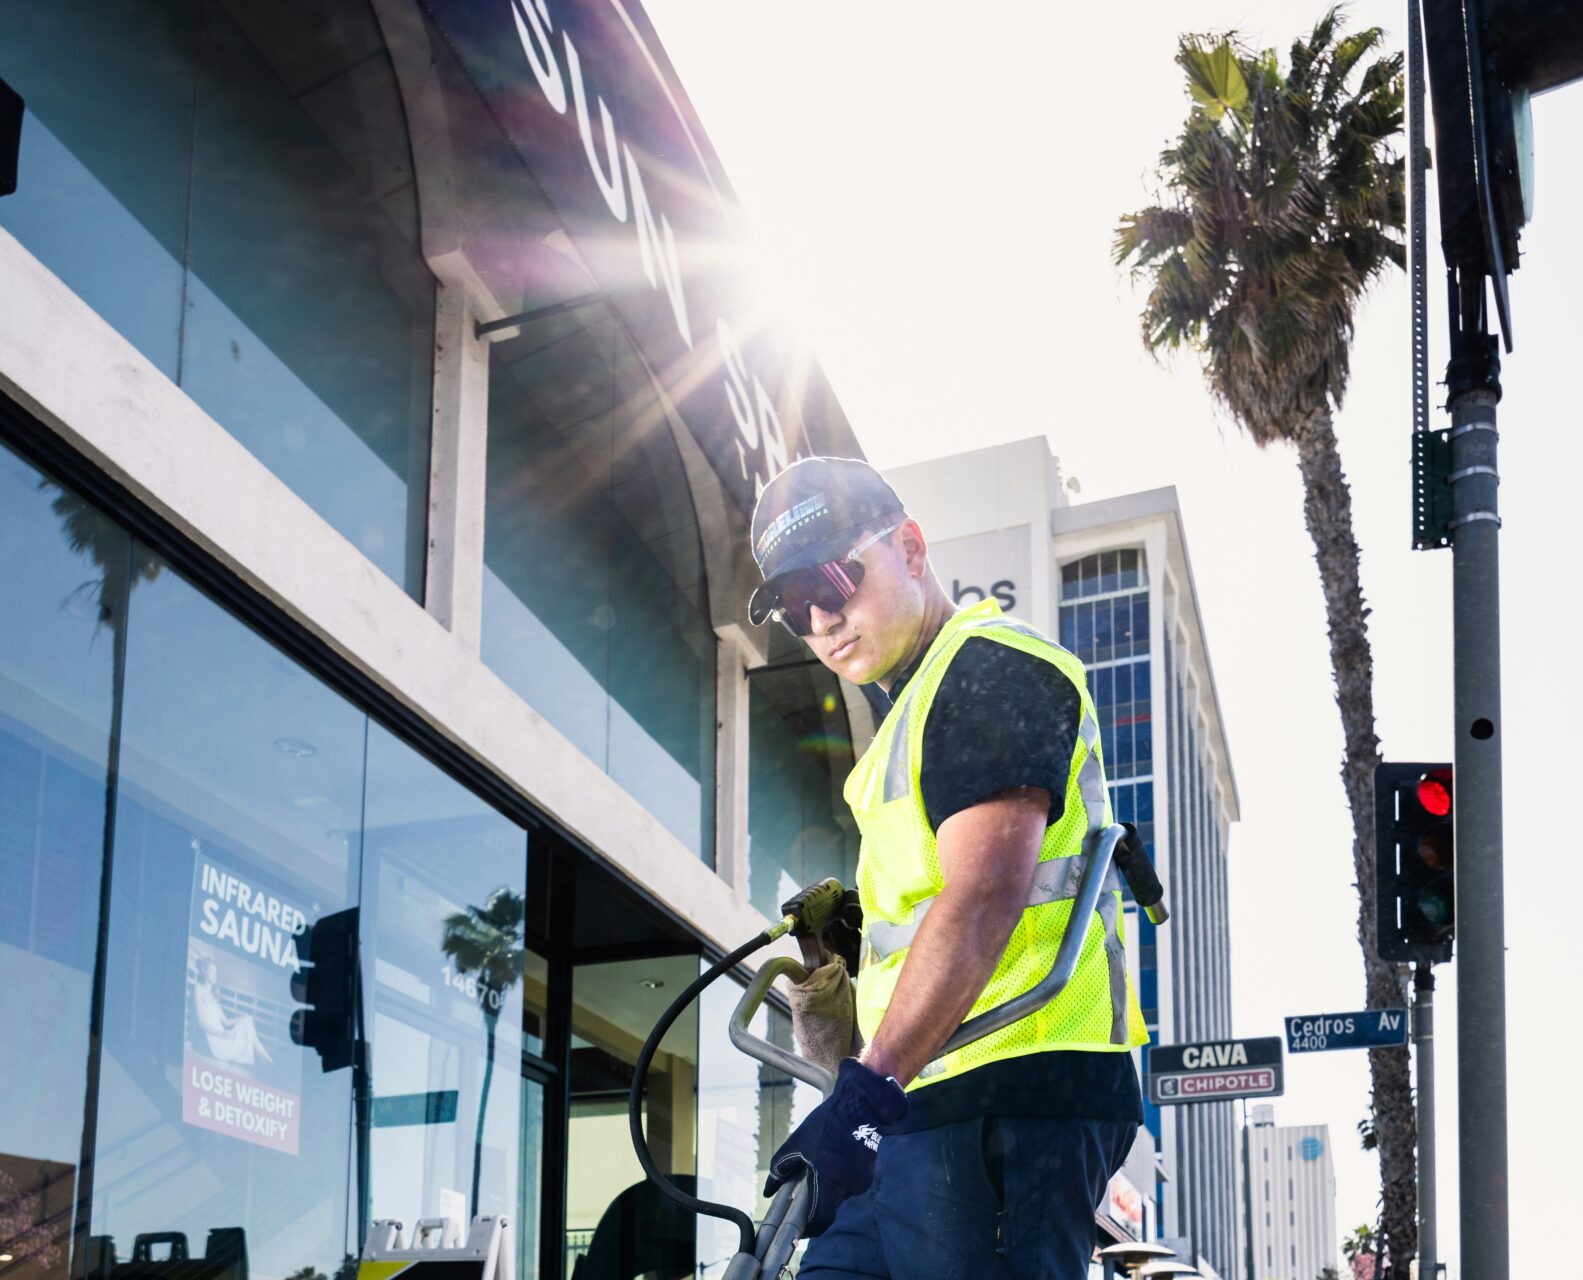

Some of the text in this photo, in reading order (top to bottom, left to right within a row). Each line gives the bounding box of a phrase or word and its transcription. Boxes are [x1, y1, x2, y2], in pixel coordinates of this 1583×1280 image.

[511, 0, 692, 352] SUN
[201, 863, 306, 936] INFRARED
[199, 898, 302, 975] SAUNA
[440, 965, 501, 1010] 14670
[1290, 1011, 1401, 1037] Cedros Av
[1291, 1035, 1327, 1050] 4400
[1182, 1043, 1248, 1069] CAVA
[191, 1066, 295, 1118] LOSE WEIGHT
[1183, 1072, 1269, 1093] CHIPOTLE
[198, 1096, 288, 1141] & DETOXIFY
